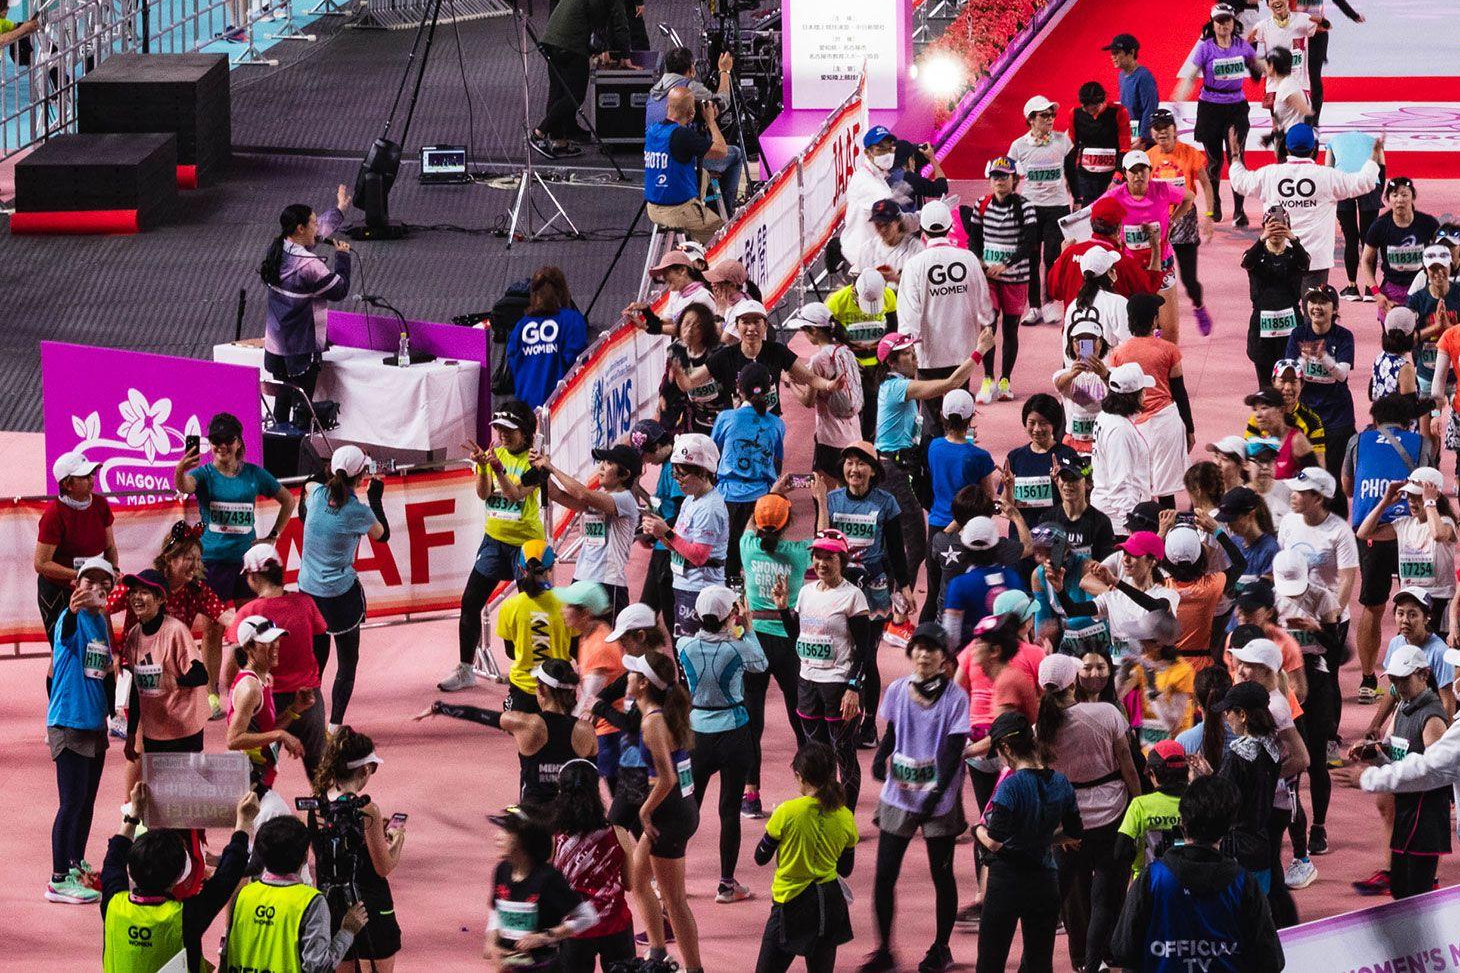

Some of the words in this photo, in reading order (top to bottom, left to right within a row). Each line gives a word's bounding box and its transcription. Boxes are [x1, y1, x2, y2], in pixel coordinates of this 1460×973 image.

[1278, 178, 1316, 198] GO
[1279, 199, 1317, 208] WOMEN
[928, 262, 967, 287] GO
[929, 285, 968, 297] WOMEN
[1261, 314, 1296, 328] H18561
[521, 319, 558, 344] GO
[522, 341, 559, 356] WOMEN
[116, 470, 170, 490] NAGOYA
[1361, 478, 1408, 499] PHO
[256, 905, 275, 920] GO
[128, 925, 152, 940] GO
[1352, 949, 1447, 973] OMEN'S
